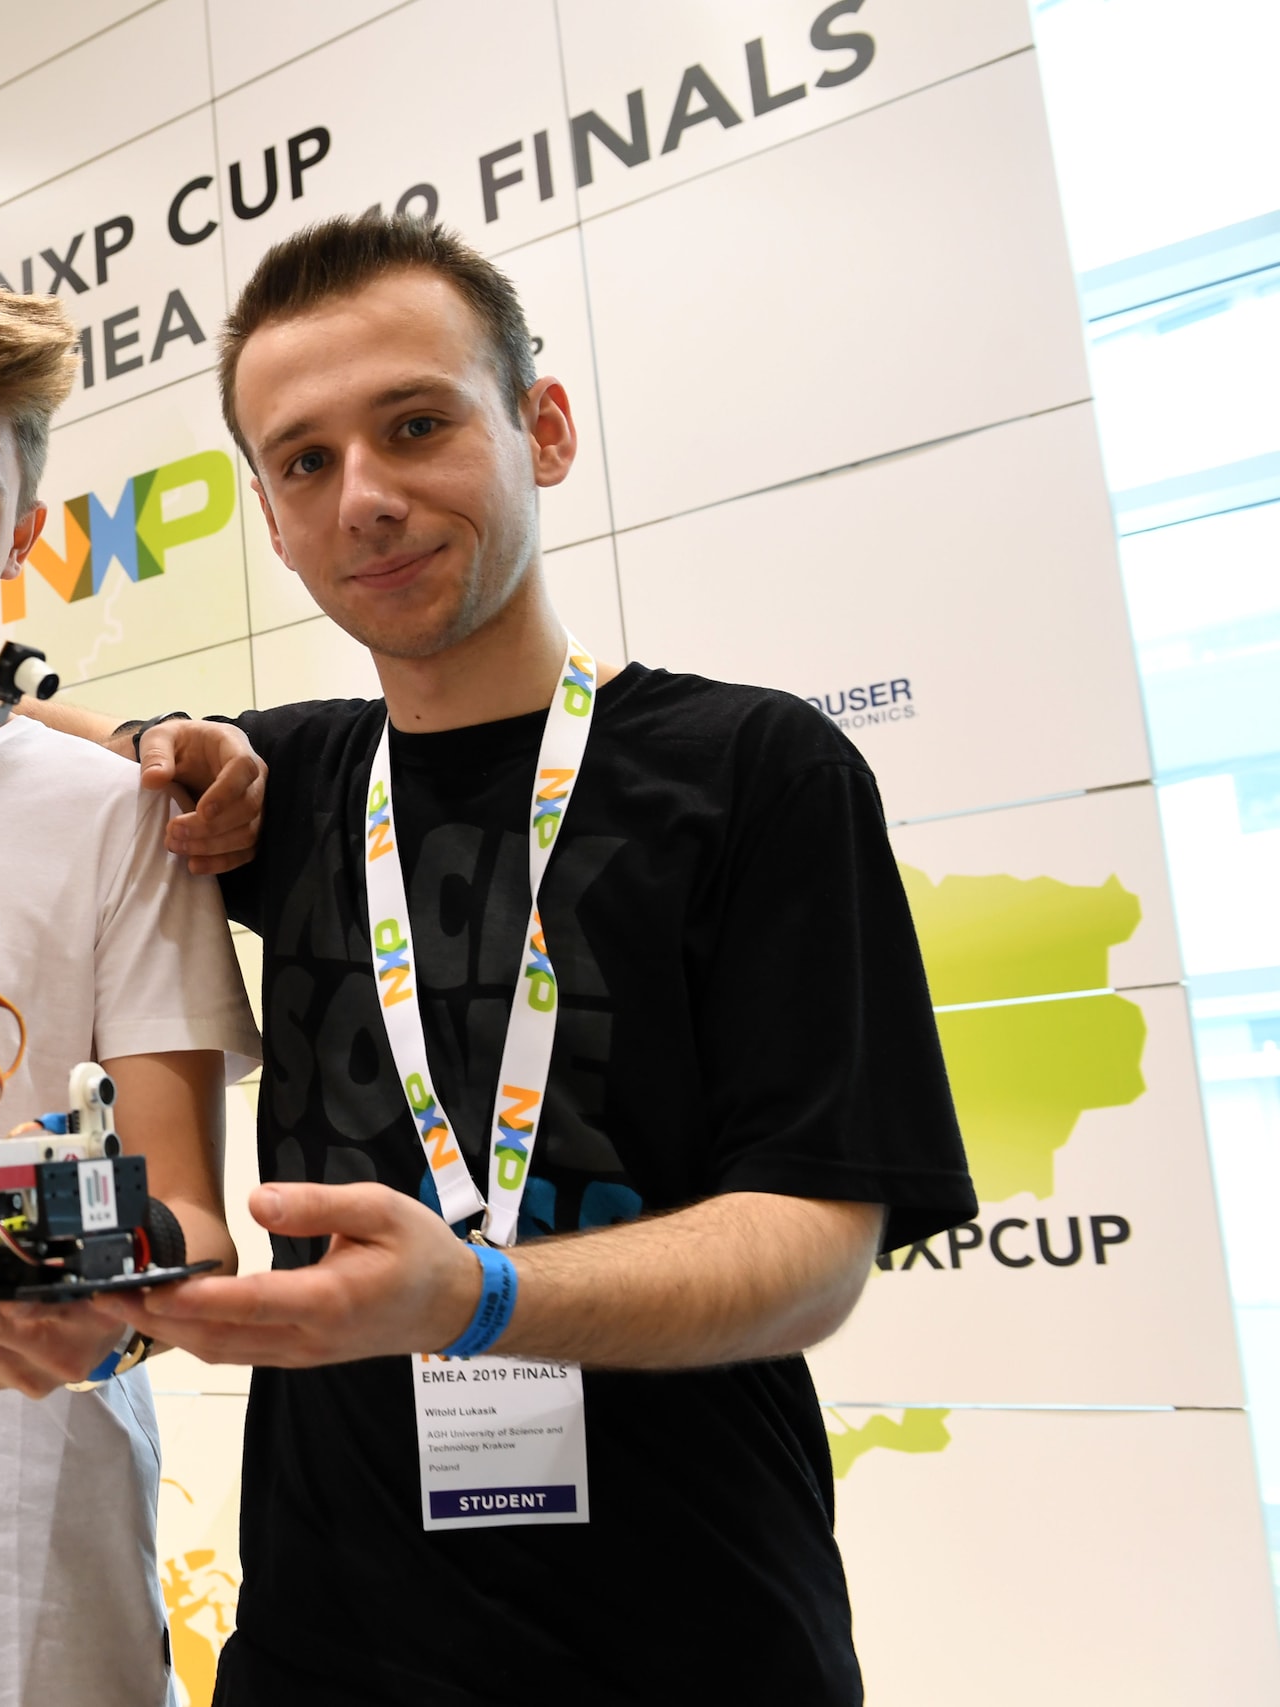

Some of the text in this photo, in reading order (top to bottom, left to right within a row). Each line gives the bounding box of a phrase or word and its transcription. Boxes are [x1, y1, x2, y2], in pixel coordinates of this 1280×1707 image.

[79, 0, 876, 389] EA FINALS
[167, 126, 331, 246] CUP
[0, 450, 236, 624] NXP
[806, 678, 912, 716] USER
[838, 705, 915, 730] RONICS
[368, 780, 394, 863] NXP
[533, 769, 576, 849] NXP
[374, 918, 413, 1008] NXP
[405, 1072, 459, 1171] NXP
[494, 1084, 541, 1191] NXP
[876, 1214, 1130, 1271] XPCUP
[422, 1365, 568, 1383] EMEA 2019 FINALS
[425, 1406, 497, 1417] Witold Lukasik
[427, 1431, 448, 1439] AGH
[450, 1430, 495, 1438] University
[509, 1428, 544, 1436] Science
[546, 1426, 563, 1434] and
[428, 1444, 480, 1453] Technology
[429, 1463, 460, 1472] Poland
[459, 1493, 547, 1511] STUDENT
